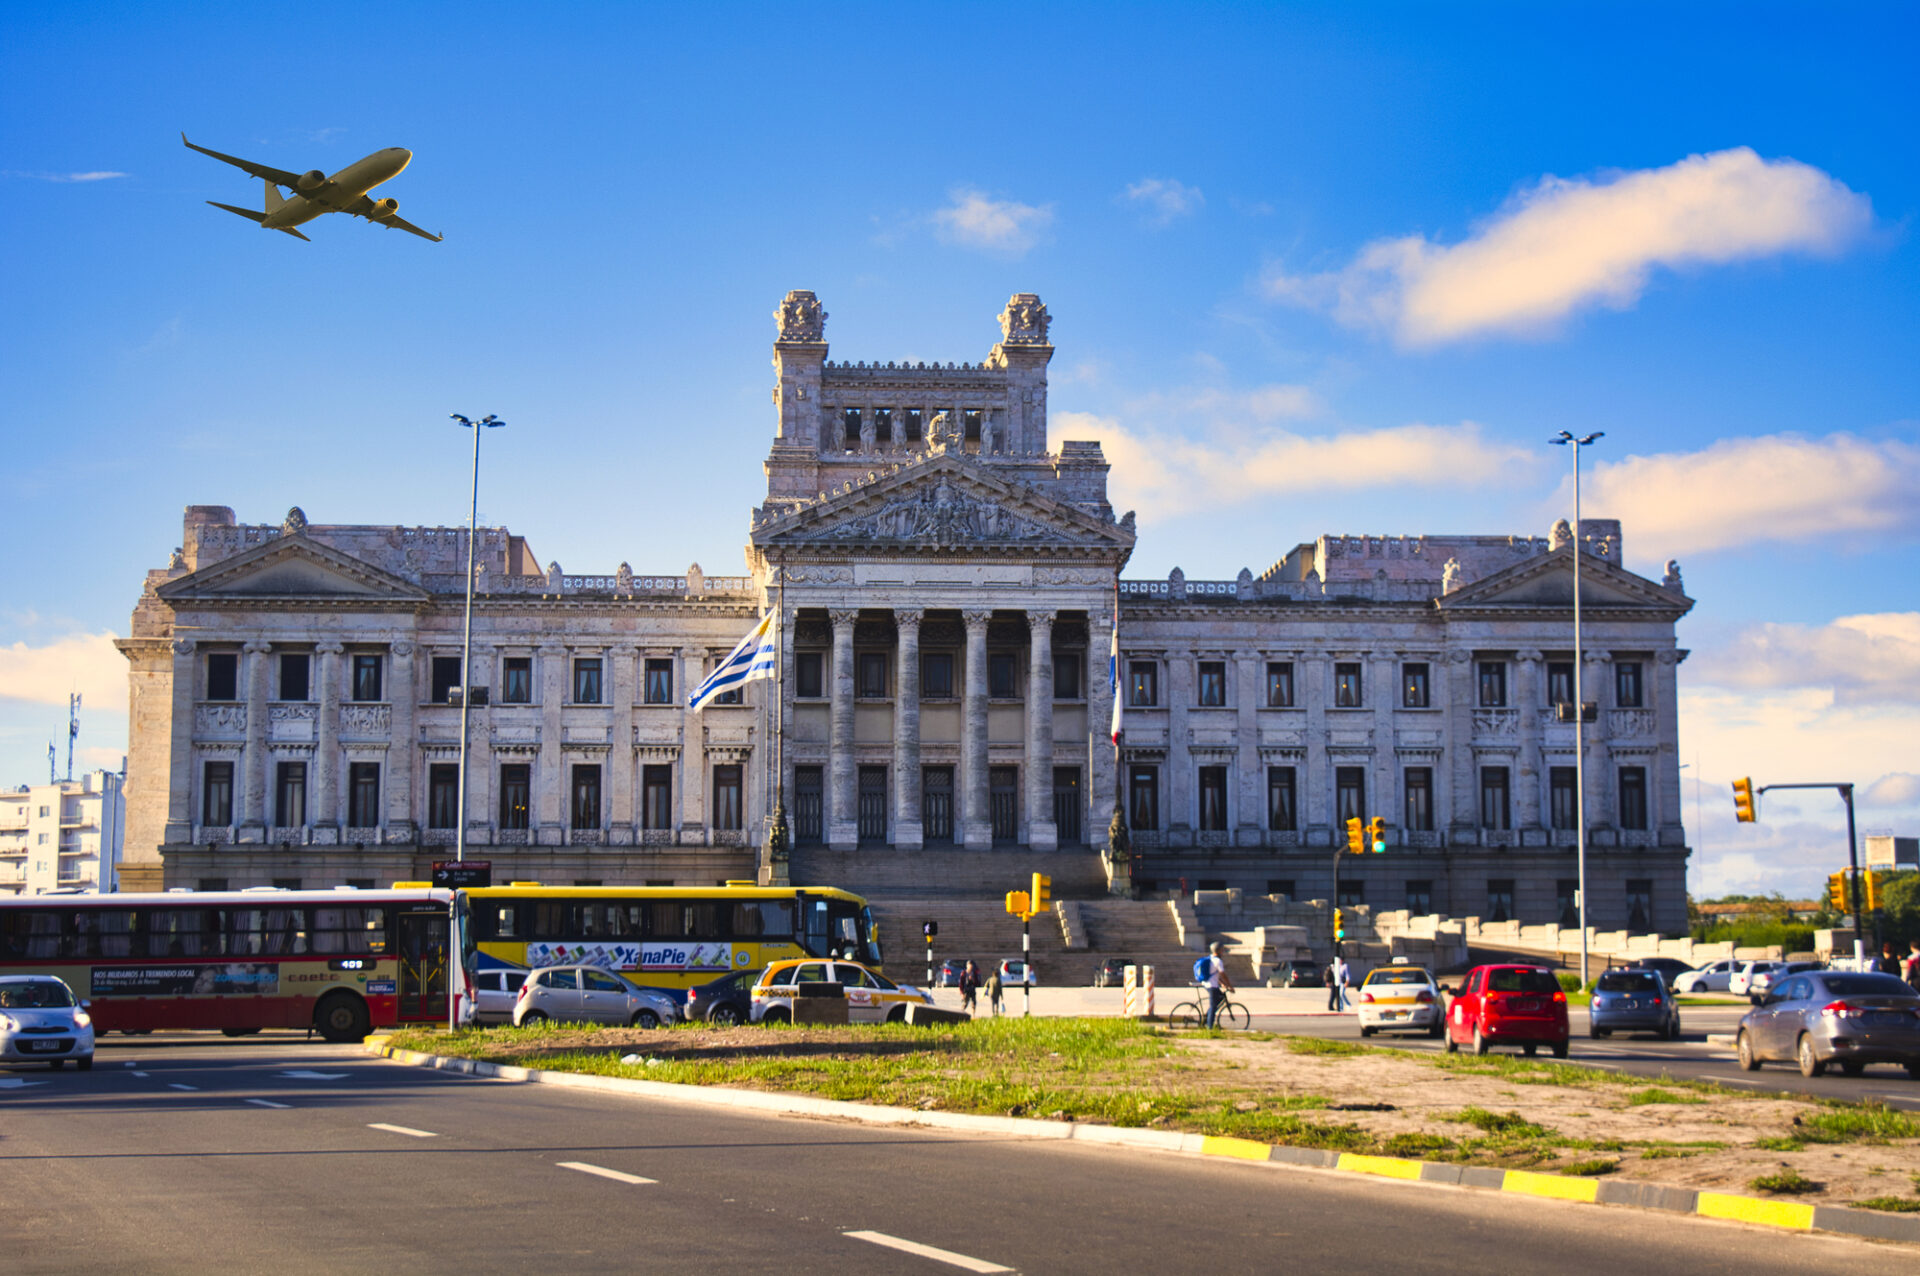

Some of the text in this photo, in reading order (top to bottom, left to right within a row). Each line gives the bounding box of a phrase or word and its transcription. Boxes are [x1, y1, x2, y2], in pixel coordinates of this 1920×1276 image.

[622, 948, 686, 964] XanaPie
[341, 960, 363, 969] 409
[107, 970, 139, 978] MUDAMOS
[177, 969, 195, 977] LOCAL
